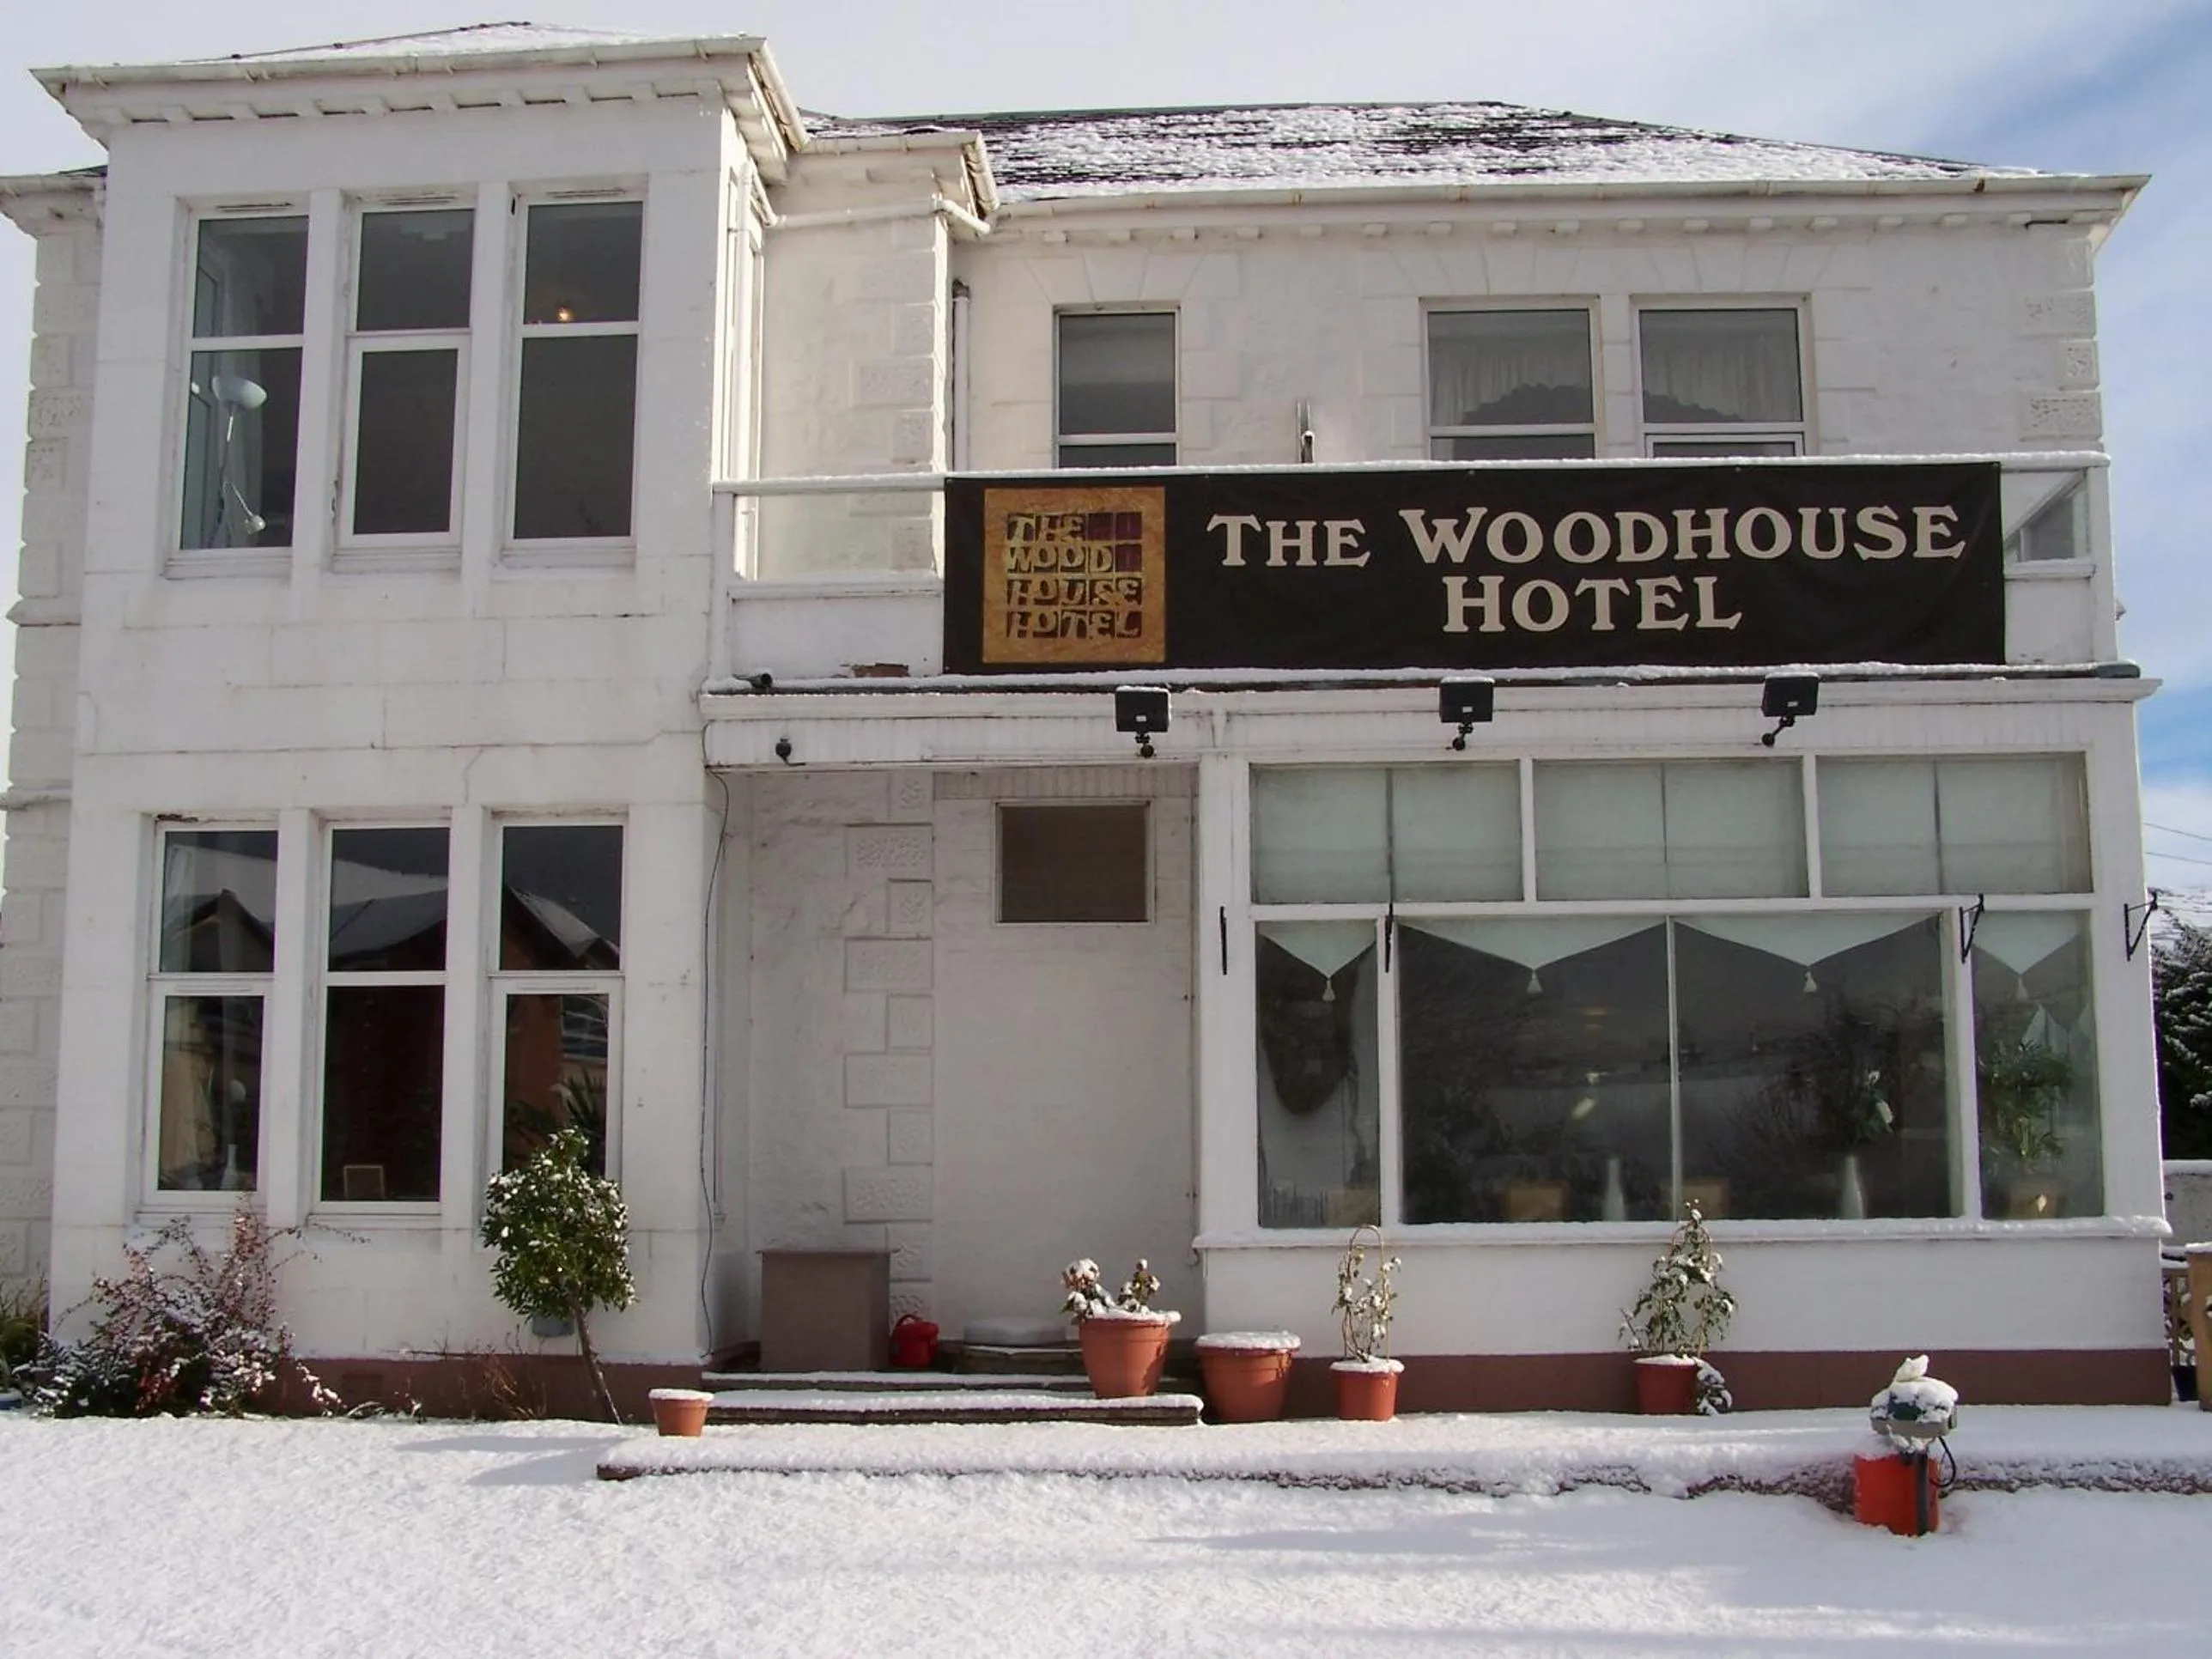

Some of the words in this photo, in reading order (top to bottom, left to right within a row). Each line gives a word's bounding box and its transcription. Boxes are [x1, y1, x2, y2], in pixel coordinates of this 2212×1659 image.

[1006, 513, 1086, 541] THE
[1207, 515, 1370, 567] THE
[1399, 506, 1966, 562] WOODHOUSE
[1006, 544, 1114, 574] WOOD
[1006, 576, 1142, 606] HOUSE
[1443, 576, 1741, 631] HOTEL
[1006, 610, 1142, 639] HOTEL
